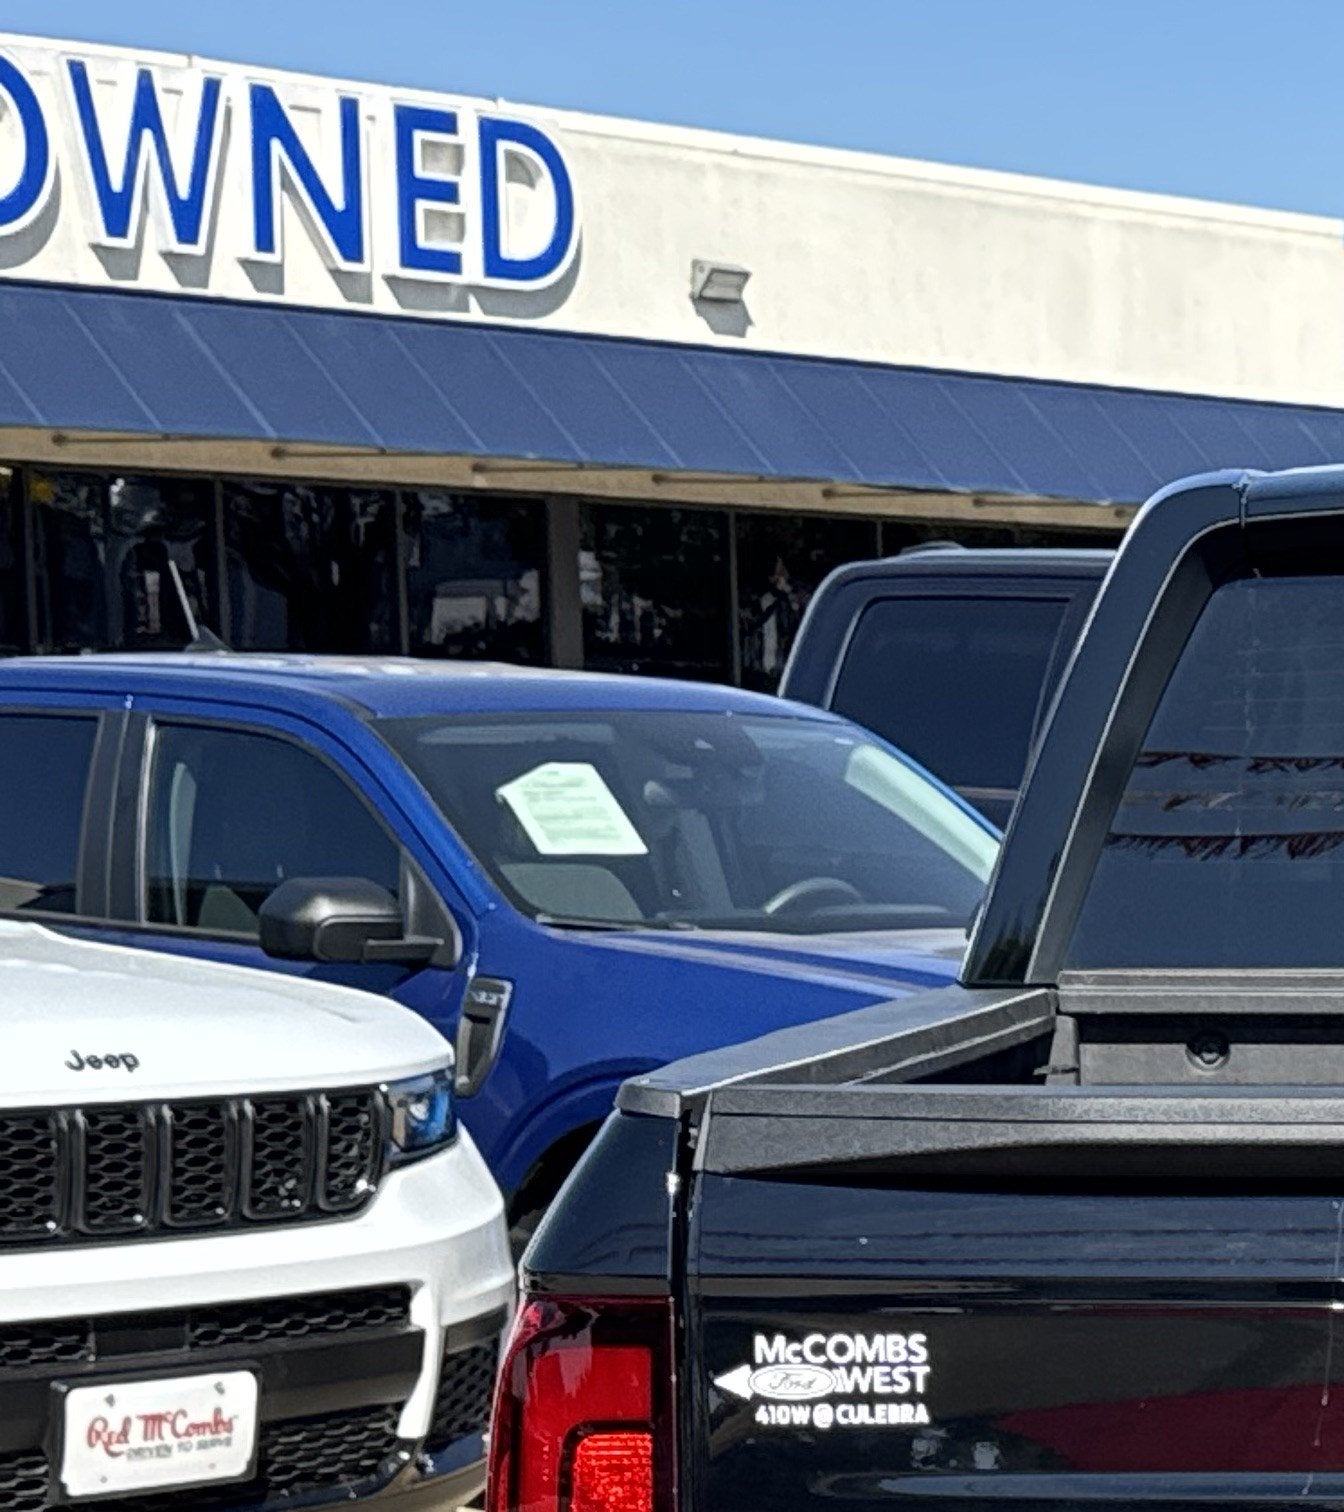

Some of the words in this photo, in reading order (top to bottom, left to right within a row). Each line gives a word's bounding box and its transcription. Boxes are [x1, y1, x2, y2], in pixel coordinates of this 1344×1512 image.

[64, 1049, 140, 1073] Jeep
[754, 1332, 929, 1364] McCOMBS
[768, 1371, 818, 1390] Ford
[838, 1365, 931, 1394] WEST
[87, 1416, 132, 1458] Red
[136, 1407, 234, 1441] McCombs
